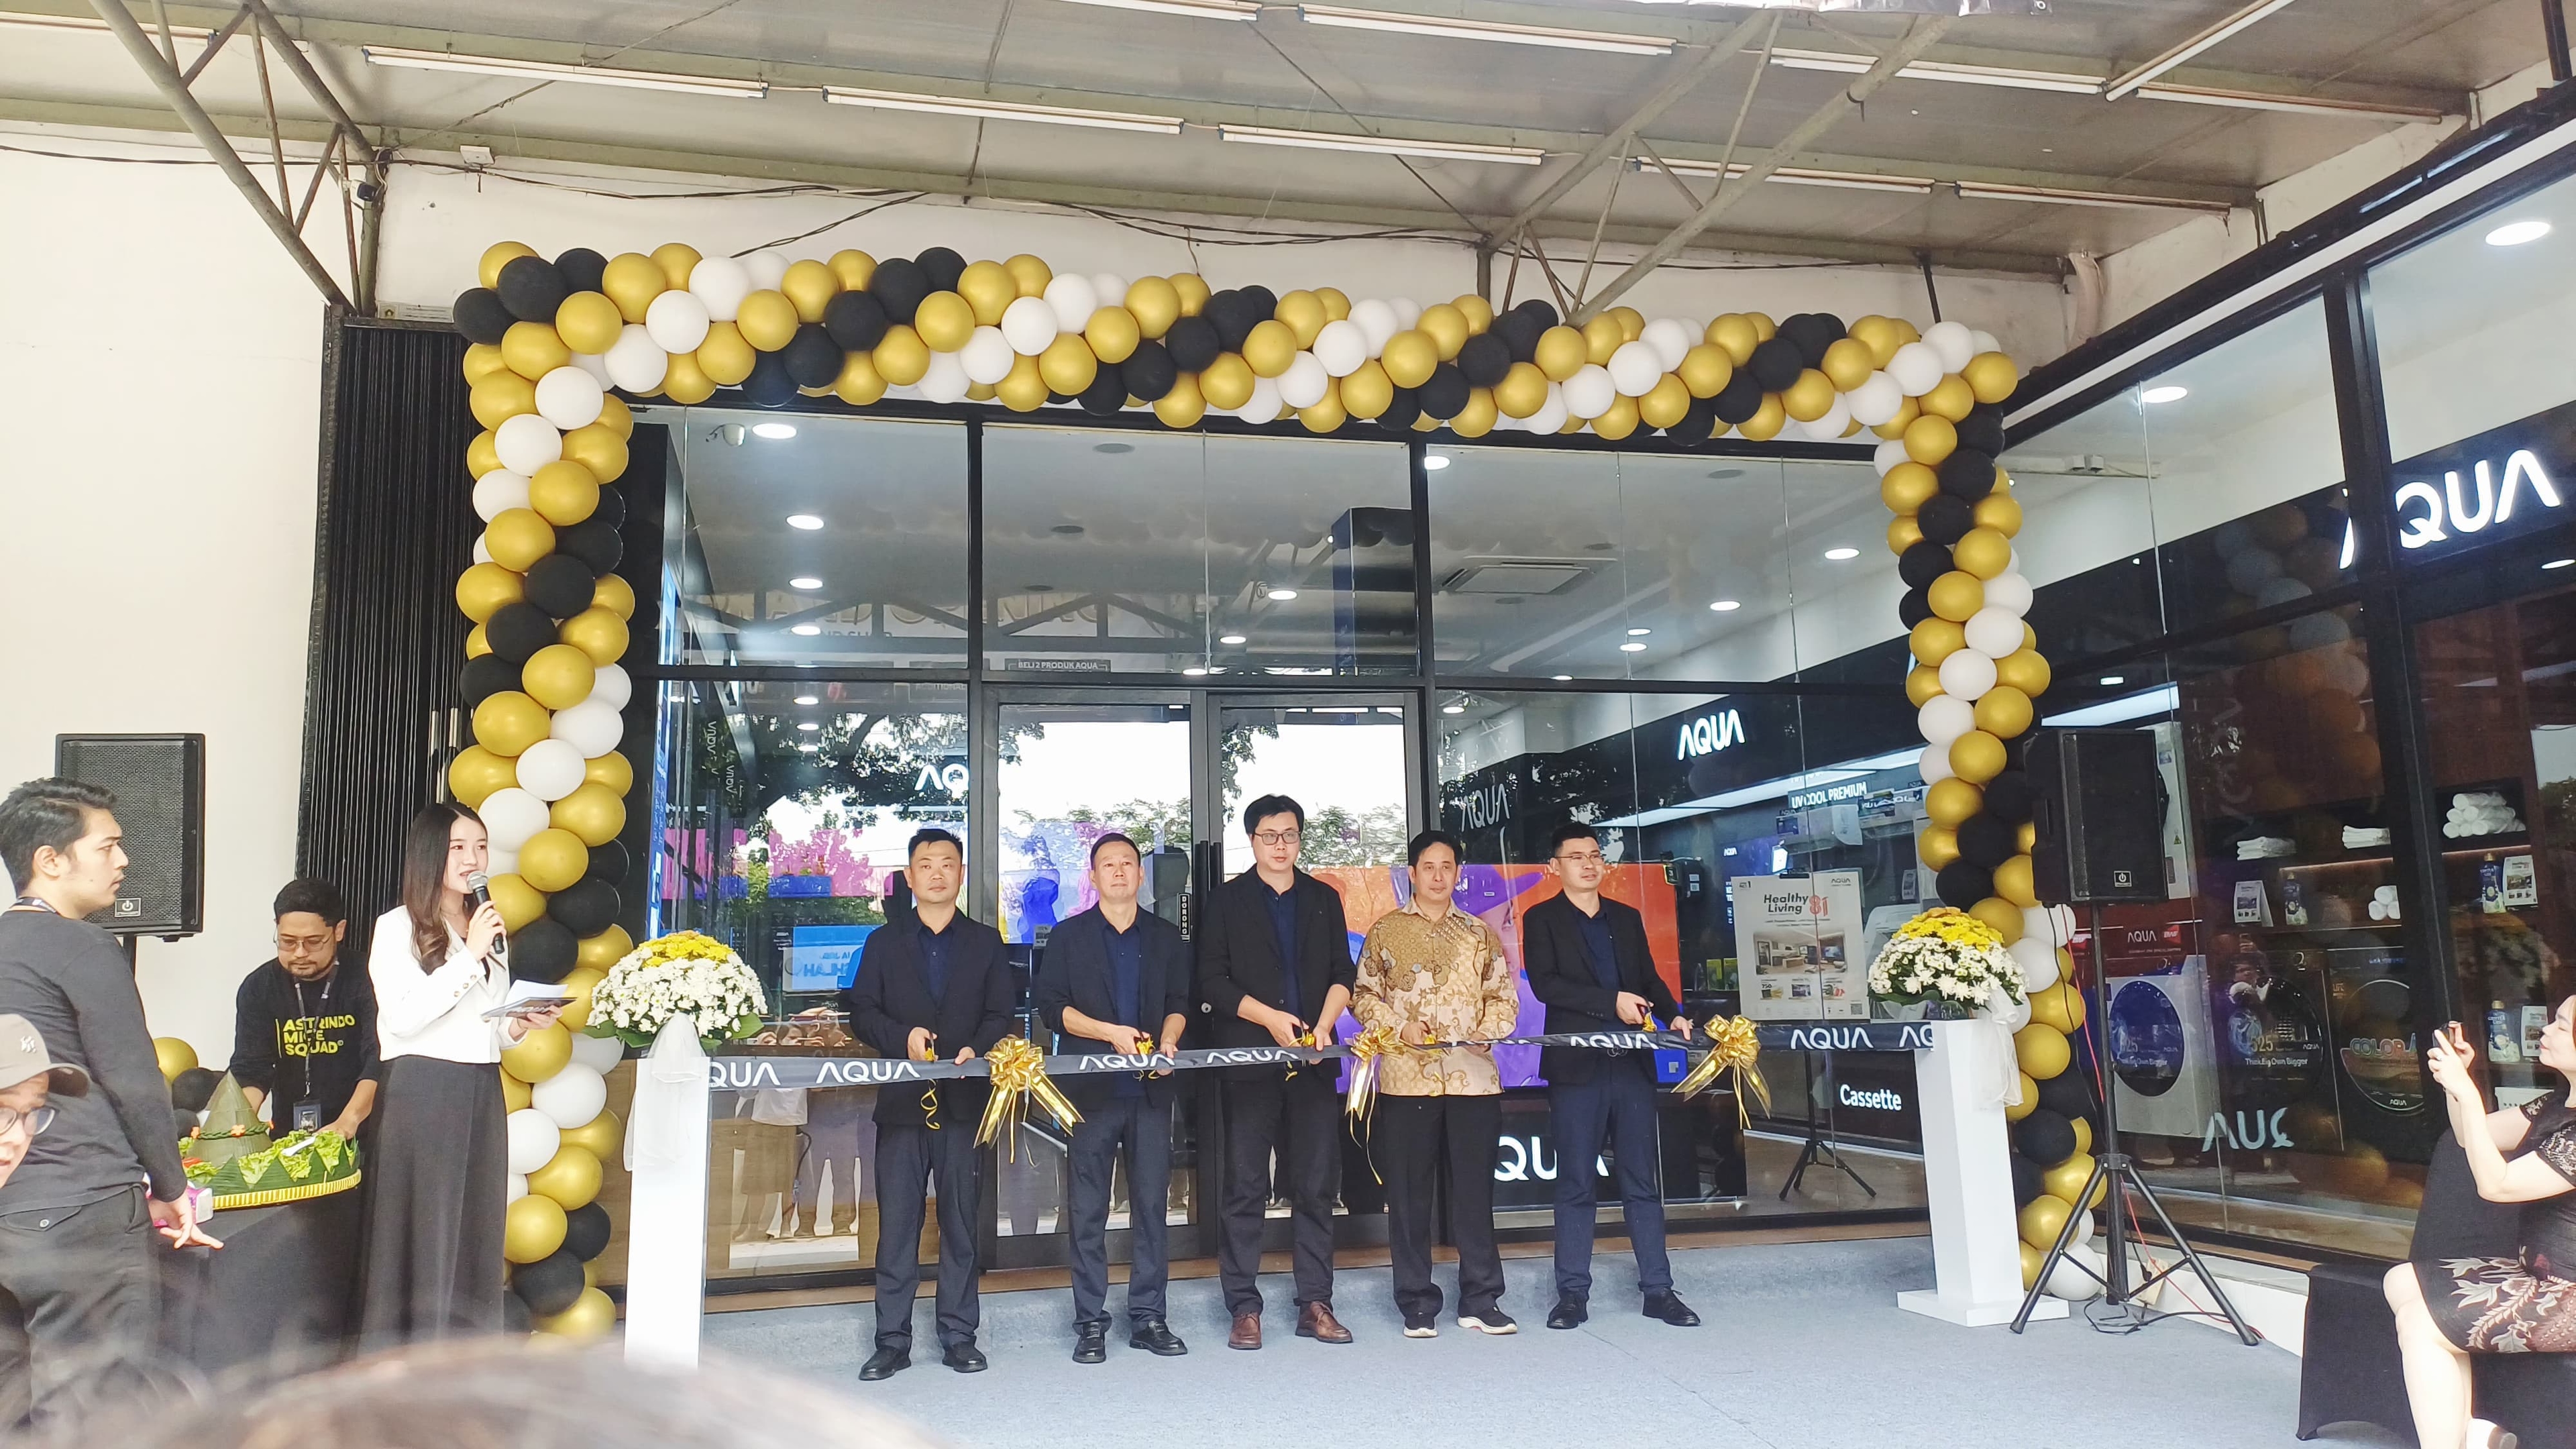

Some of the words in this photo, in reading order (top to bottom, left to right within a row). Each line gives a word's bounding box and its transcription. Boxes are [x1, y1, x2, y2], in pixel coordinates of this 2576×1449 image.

[1075, 661, 1099, 669] AQUA
[1678, 708, 1746, 761] AQUA
[1792, 796, 1803, 809] UV
[1828, 782, 1868, 801] PREMIUM
[1461, 784, 1510, 832] AQUA
[1764, 894, 1809, 905] Healthy
[1768, 904, 1803, 915] Living
[2127, 930, 2157, 943] AQUA
[1790, 1026, 1874, 1050] AQUA
[1079, 1053, 1175, 1071] AQUA
[1208, 1049, 1299, 1065] AQUA
[816, 1061, 920, 1084] AQUA
[1839, 1083, 1902, 1111] Cassette
